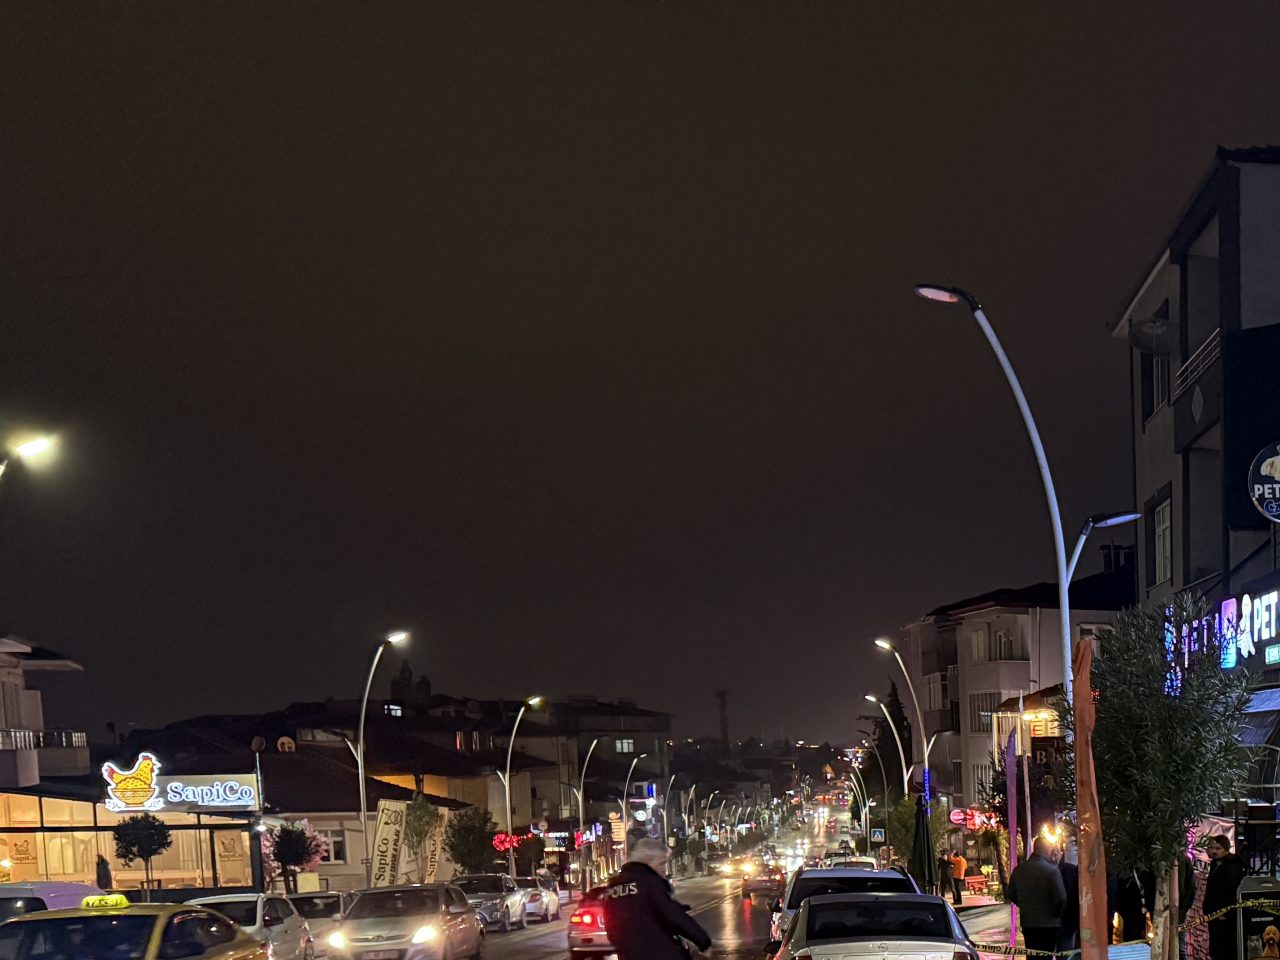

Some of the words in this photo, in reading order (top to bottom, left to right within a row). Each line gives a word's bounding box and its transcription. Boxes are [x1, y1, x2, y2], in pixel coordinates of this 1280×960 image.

[1254, 484, 1280, 499] PET
[1253, 589, 1278, 643] PET
[166, 780, 255, 806] SapiCo
[375, 838, 390, 881] SapiCo
